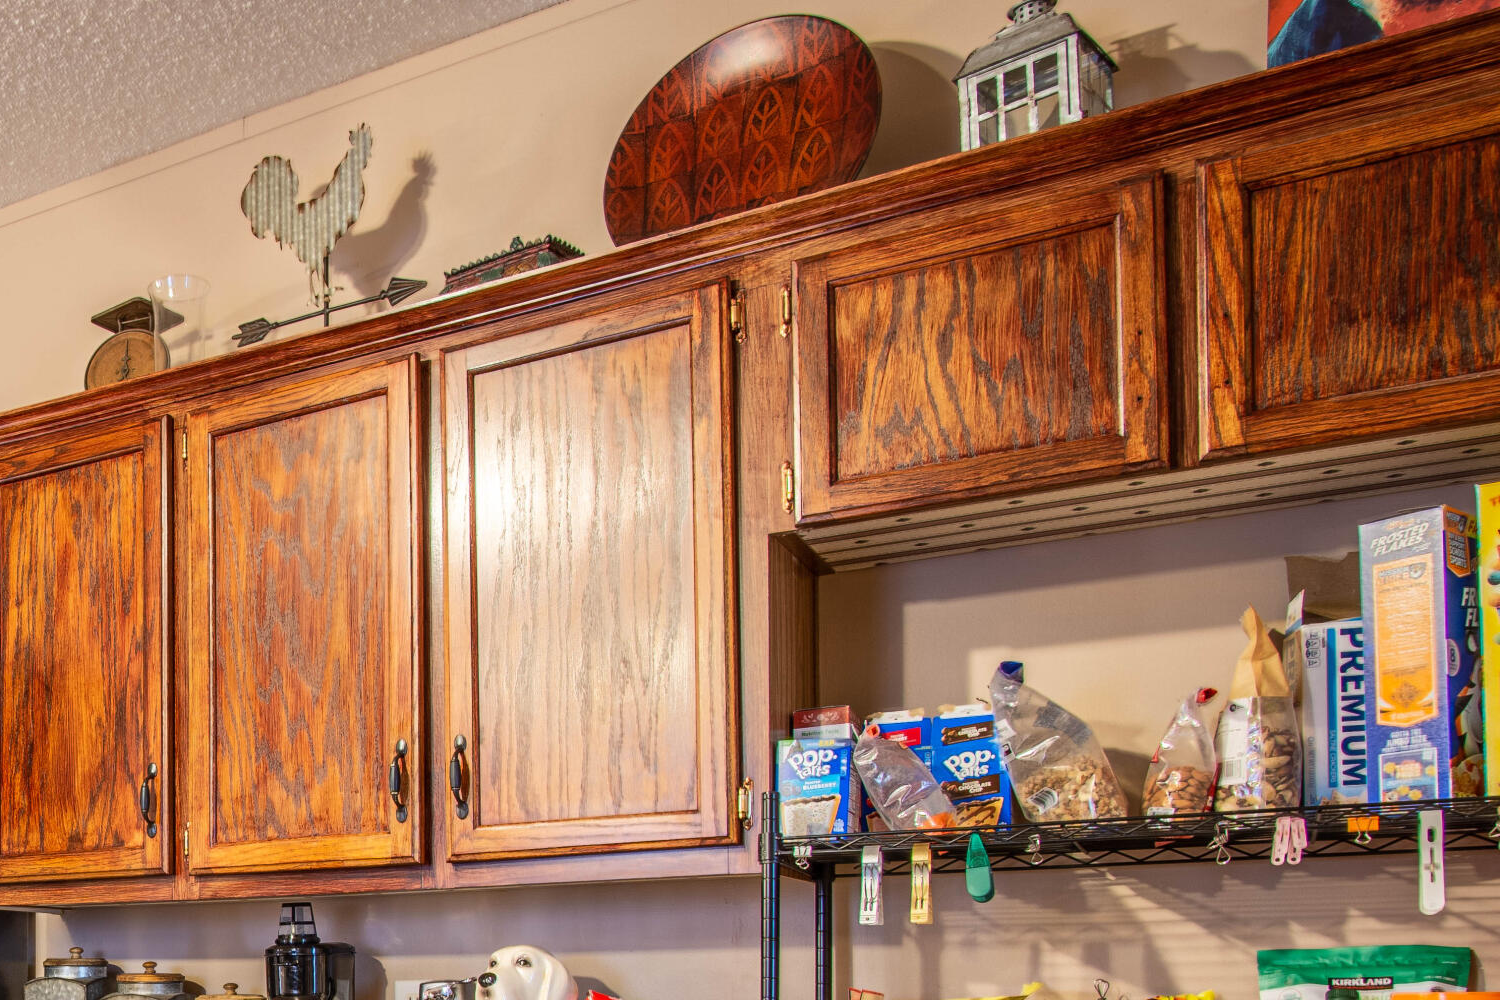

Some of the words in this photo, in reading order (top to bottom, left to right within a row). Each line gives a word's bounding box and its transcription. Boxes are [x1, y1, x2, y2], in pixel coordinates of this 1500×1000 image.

[1370, 522, 1429, 549] FROSTED
[1373, 535, 1423, 557] FLAKES
[1339, 628, 1368, 786] PREMIUM
[803, 782, 837, 790] BLUEBERRY
[958, 782, 992, 791] CHOCOLATE
[1331, 977, 1393, 987] KIRKLAND
